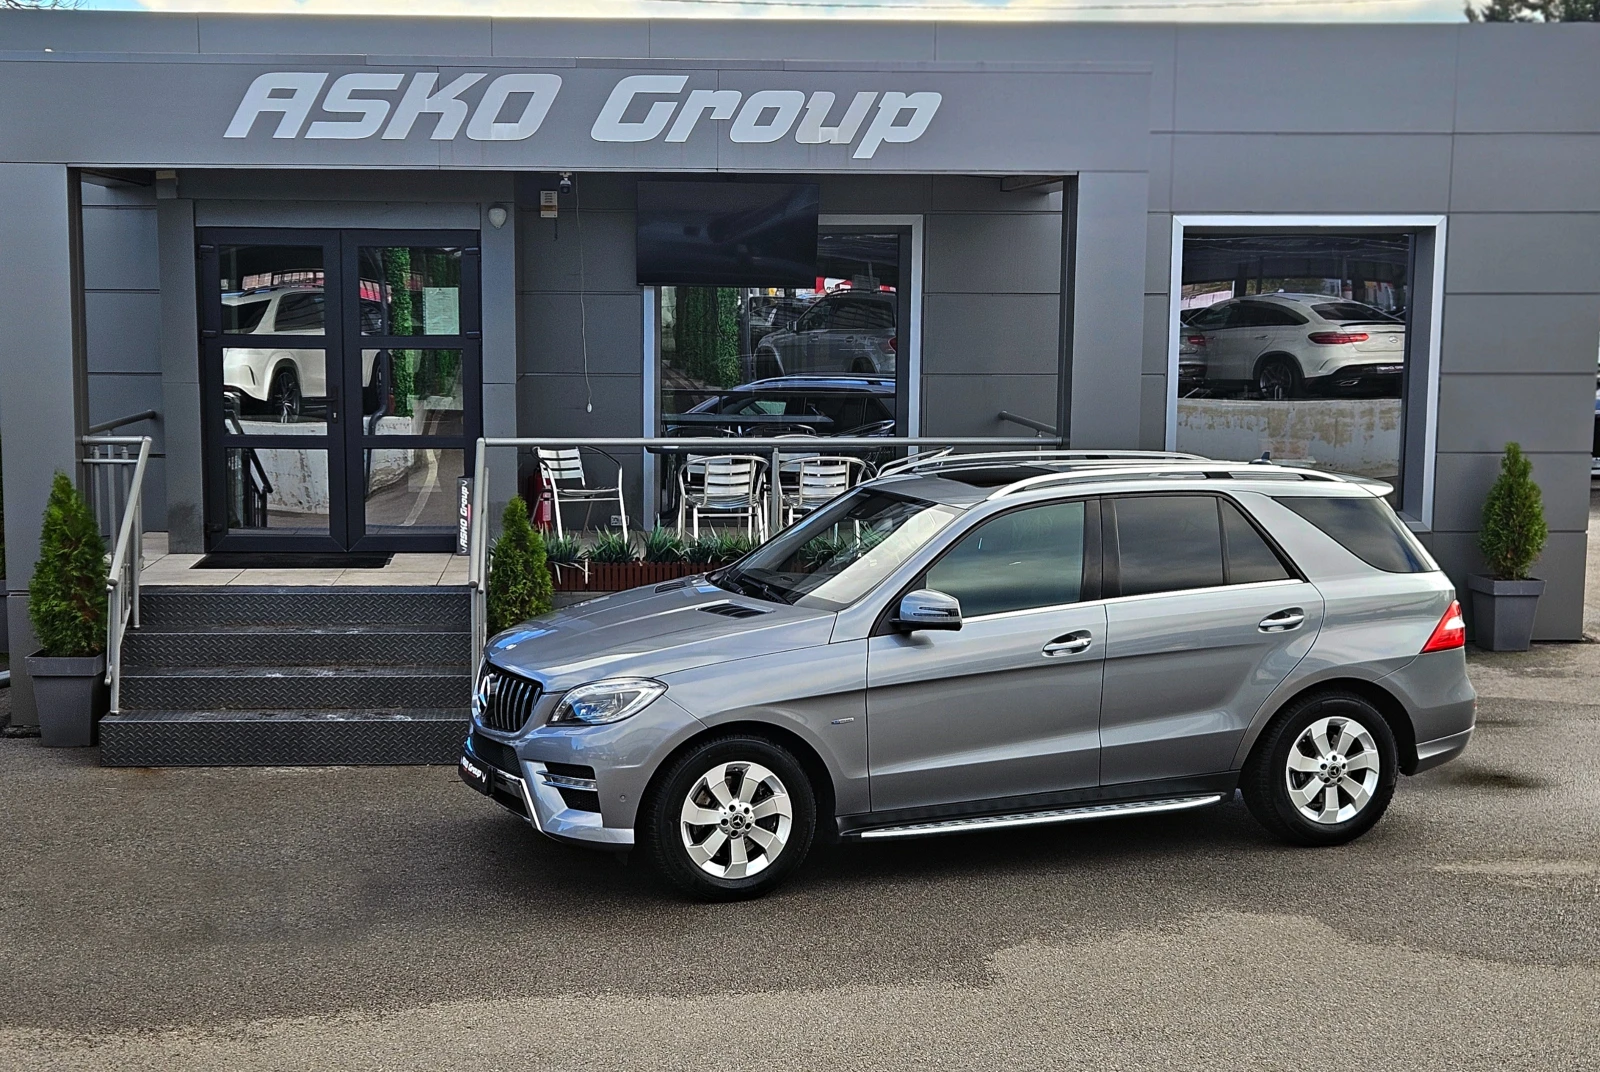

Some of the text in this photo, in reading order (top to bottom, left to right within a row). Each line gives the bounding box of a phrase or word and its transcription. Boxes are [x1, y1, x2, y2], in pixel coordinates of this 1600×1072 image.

[223, 72, 943, 159] ASKO Group
[460, 486, 469, 548] ASKO Group
